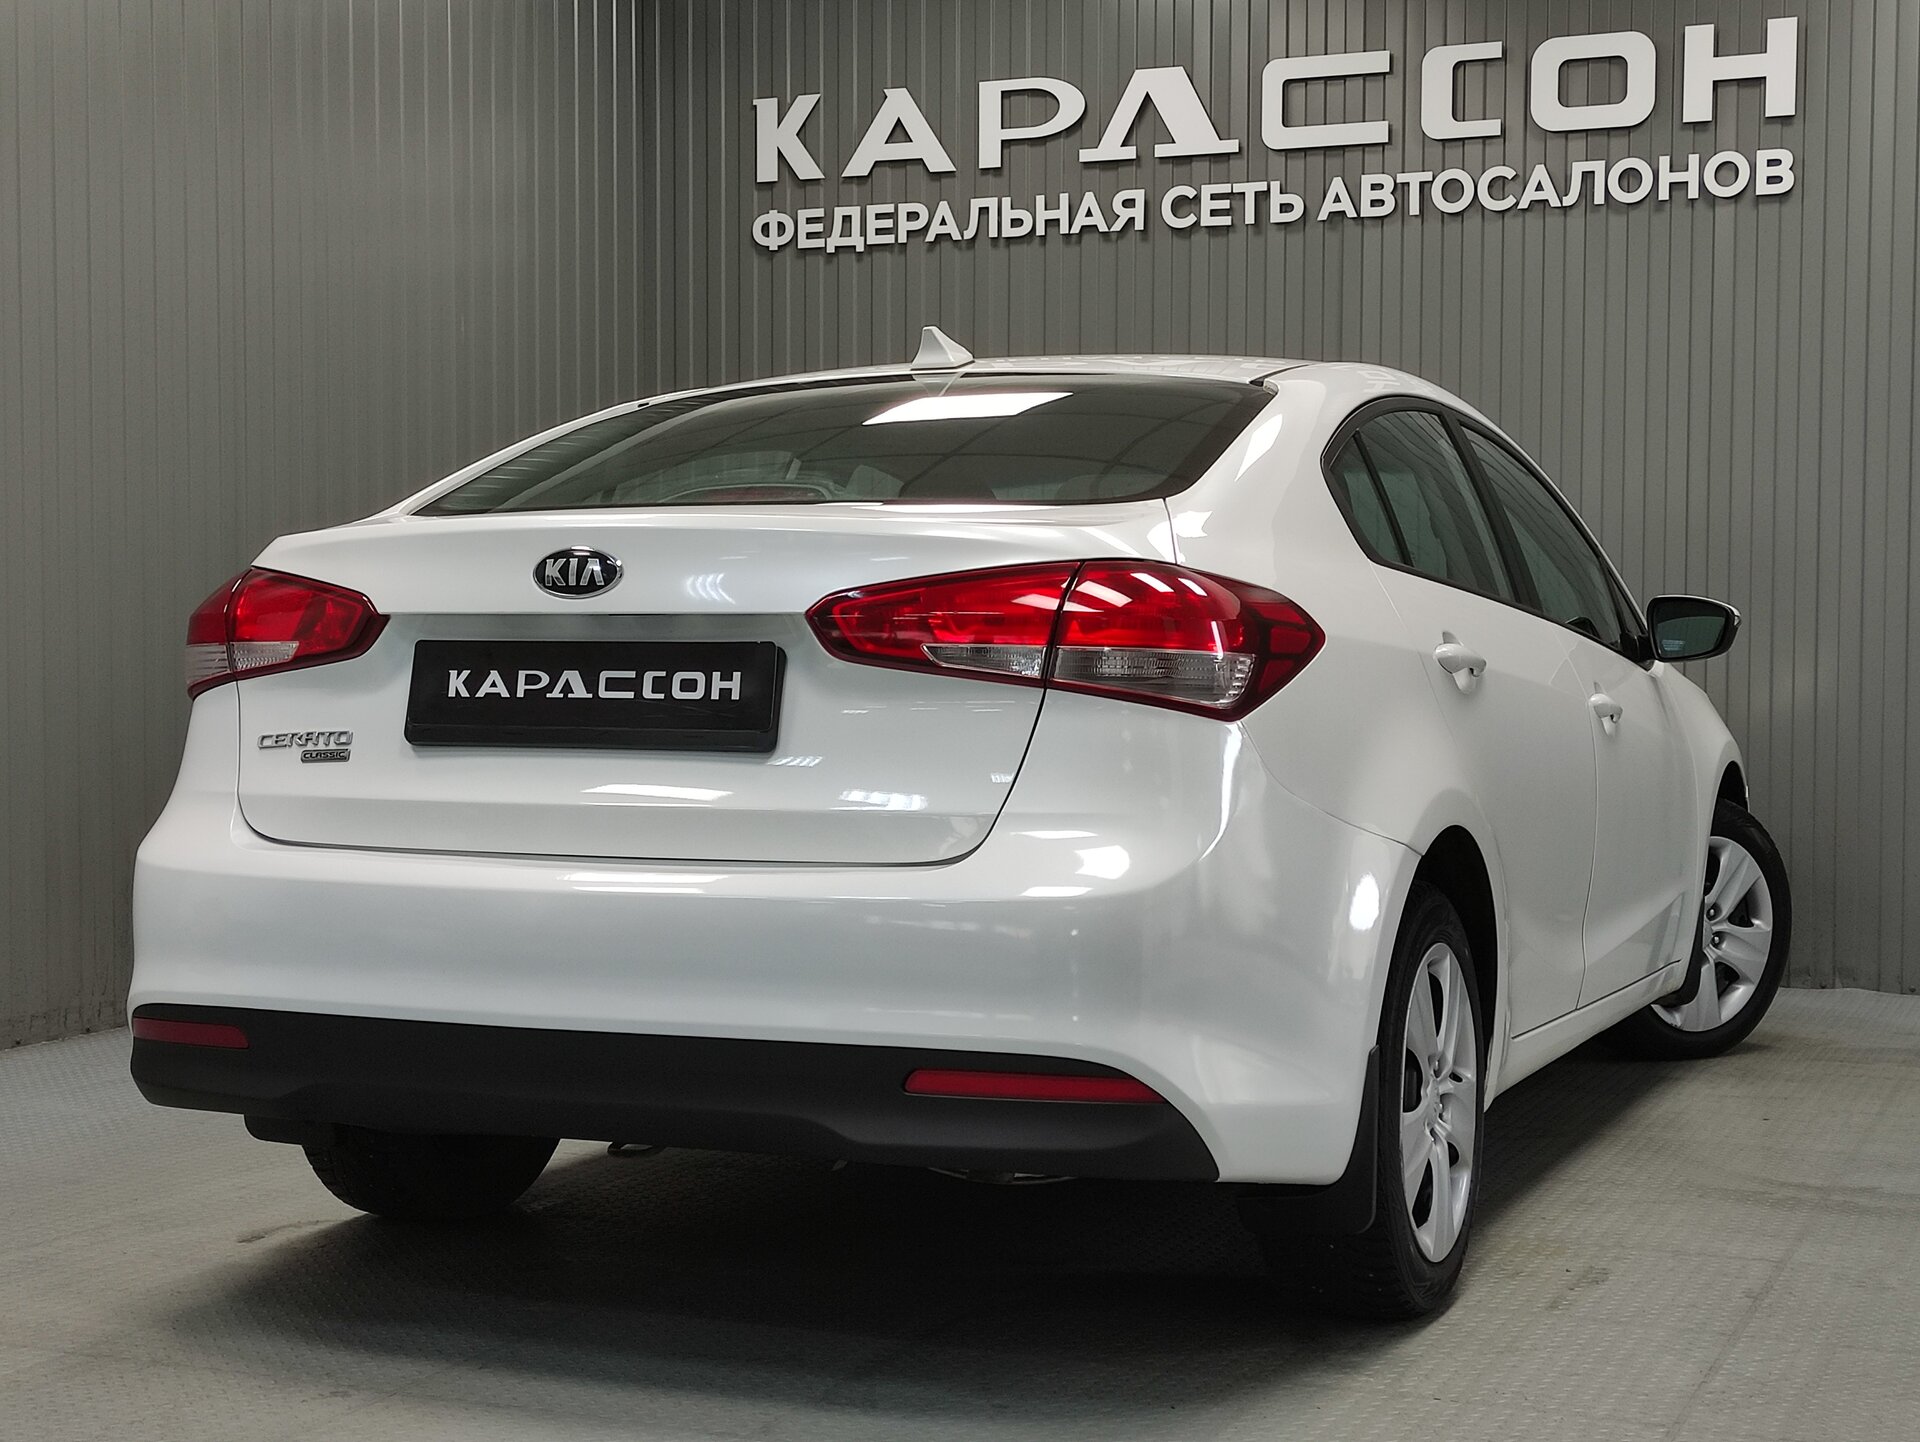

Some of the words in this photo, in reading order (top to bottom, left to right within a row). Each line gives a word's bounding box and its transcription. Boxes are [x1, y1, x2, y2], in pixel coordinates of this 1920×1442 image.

[752, 189, 1146, 253] ФЕДЕРАЛЬНАЯ
[1161, 181, 1305, 229] СЕТЬ
[1317, 148, 1796, 221] АВТОСАЛОНОВ
[544, 557, 605, 586] KIA
[257, 731, 353, 749] CERATO
[303, 751, 346, 759] CLASSIC
